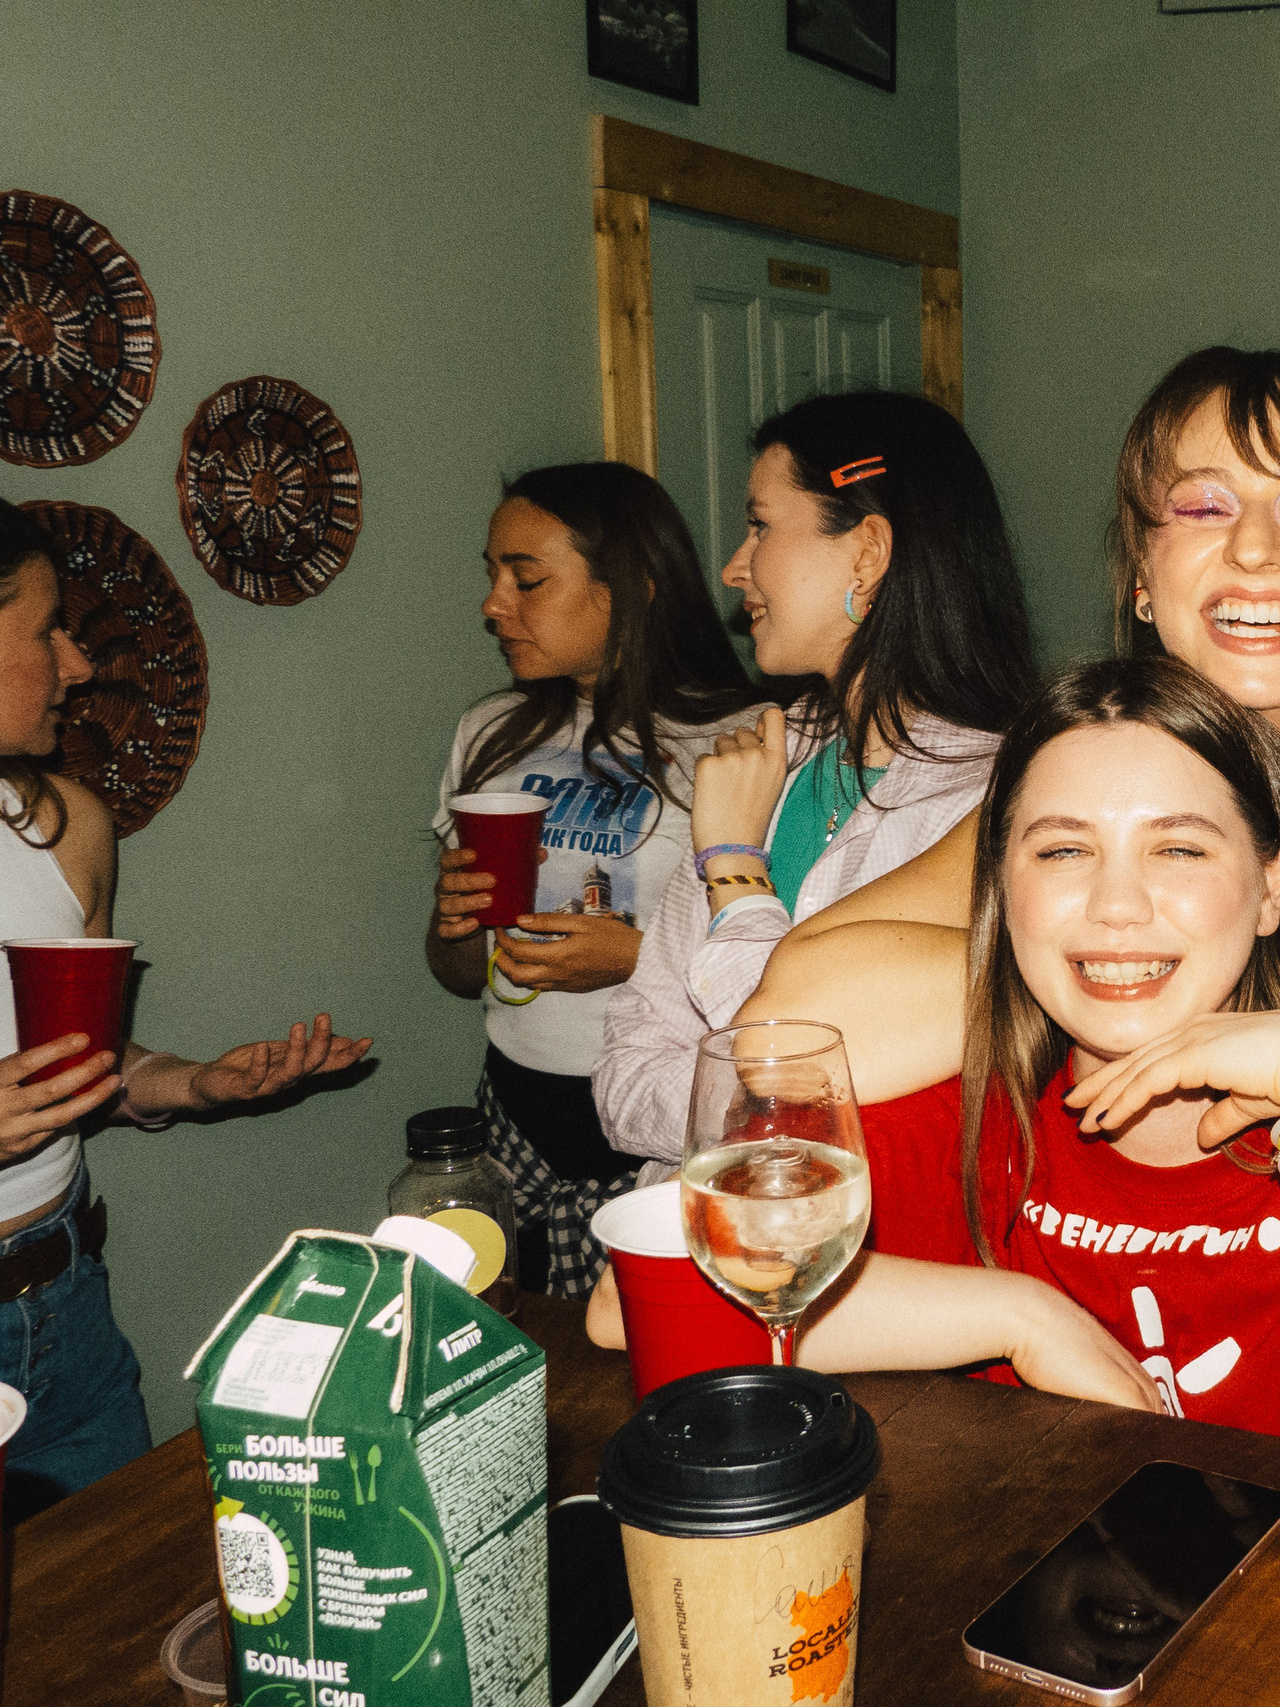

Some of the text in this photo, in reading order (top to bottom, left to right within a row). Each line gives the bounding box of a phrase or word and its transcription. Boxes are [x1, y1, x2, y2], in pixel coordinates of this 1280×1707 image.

[541, 827, 622, 857] ИК ГОДА
[438, 1338, 453, 1362] 1
[450, 1329, 482, 1358] ЛИТР
[215, 1434, 346, 1458] БЕРИ БОЛЬШЕ
[228, 1460, 319, 1483] ПОЛЬЗЫ
[258, 1484, 340, 1500] ОТ КАЖДОГО
[293, 1501, 346, 1521] УЖИНА
[317, 1560, 413, 1580] КАК ПОЛУЧИТЬ
[318, 1573, 366, 1591] БОЛЬШЕ
[319, 1586, 428, 1605] ЖИЗНЕННЫХ СИЛ
[318, 1599, 386, 1618] С БРЕНДОМ
[673, 1577, 689, 1650] ИНГРЕДИЕНТЫ
[245, 1650, 350, 1684] БОЛЬШЕ
[681, 1652, 693, 1691] ЧИСТЫЕ
[318, 1687, 366, 1707] СИЛ
